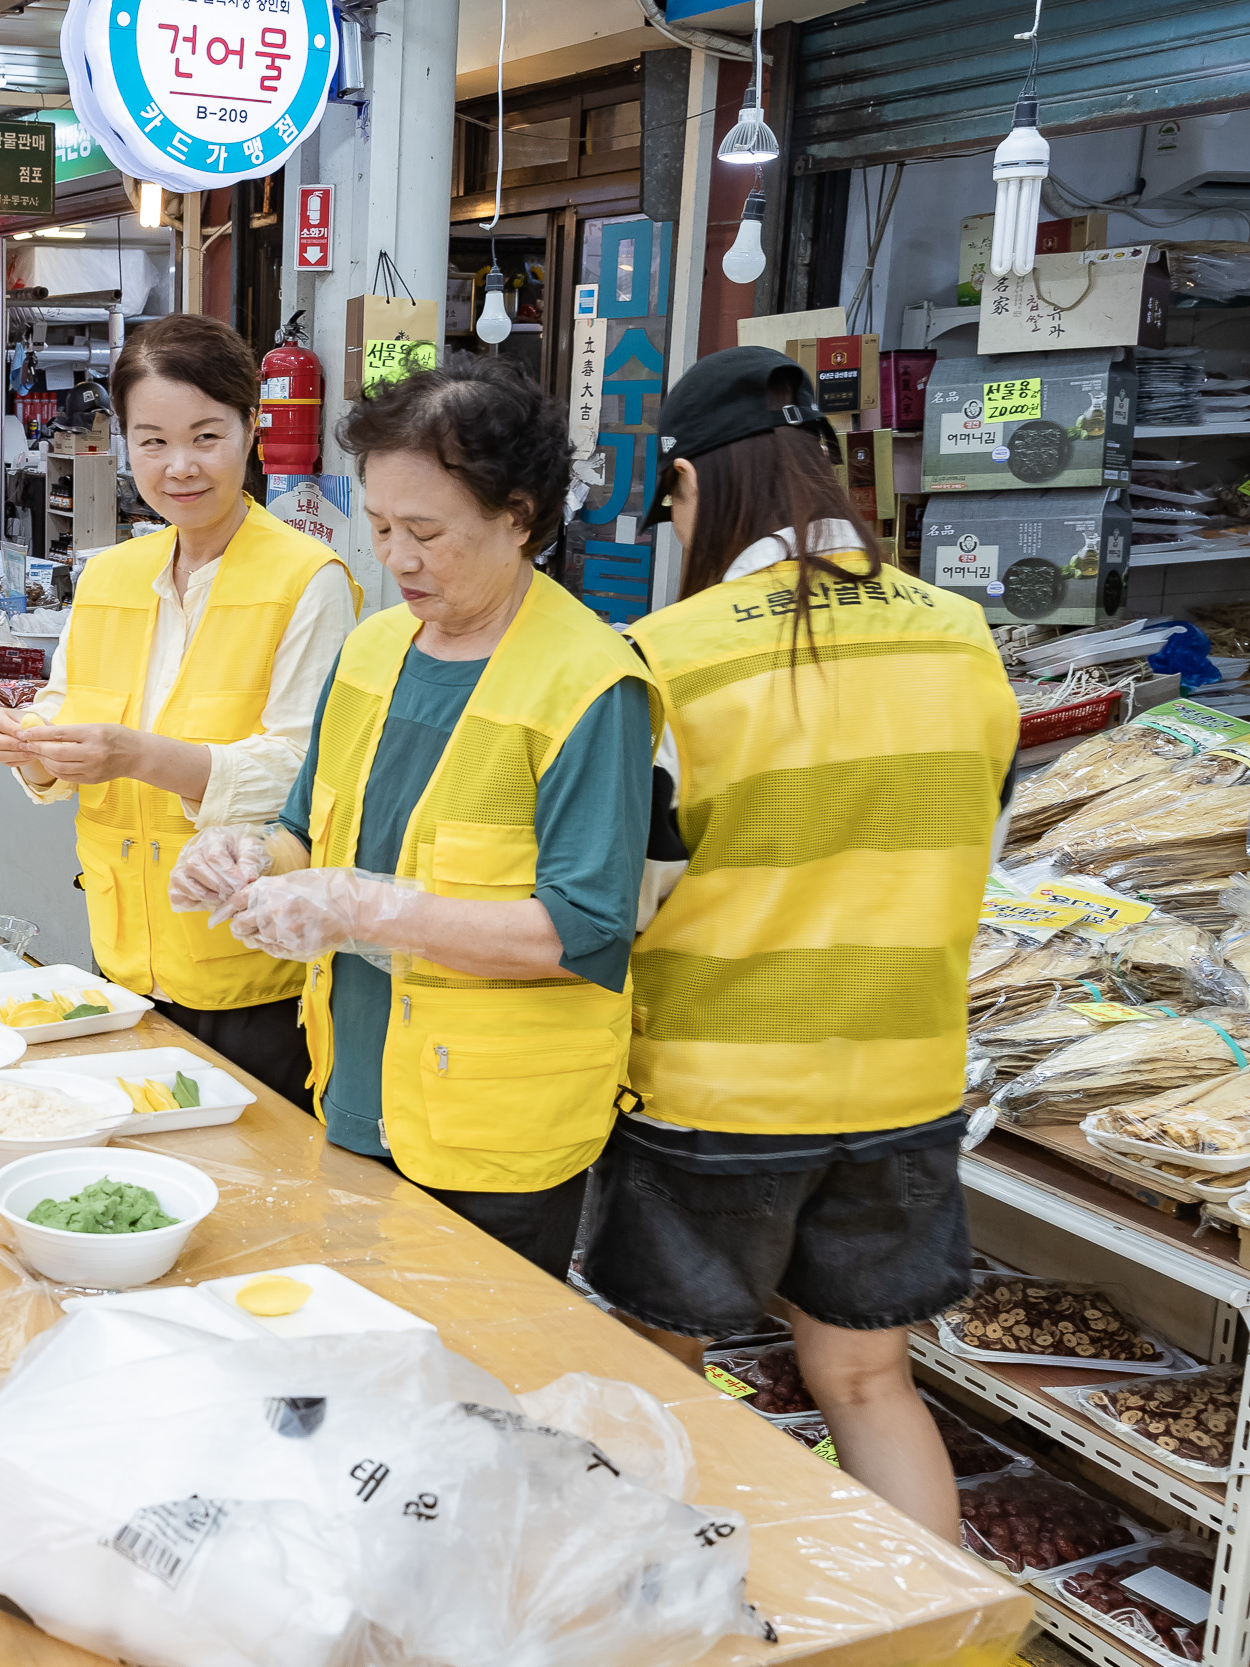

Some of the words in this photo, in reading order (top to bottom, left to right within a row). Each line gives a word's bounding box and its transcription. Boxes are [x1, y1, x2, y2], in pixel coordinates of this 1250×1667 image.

[158, 23, 291, 92] 건어물
[196, 105, 249, 123] B-209
[140, 101, 299, 172] 카드가맹점
[18, 166, 43, 184] 점포
[300, 228, 328, 238] 소화기
[580, 336, 595, 421] 立春大吉
[931, 391, 960, 405] 名品
[985, 380, 1031, 402] 선물용
[947, 431, 996, 446] 어머니김
[296, 498, 320, 518] 노룬산
[926, 524, 955, 537] 名品
[942, 566, 991, 579] 어머니김
